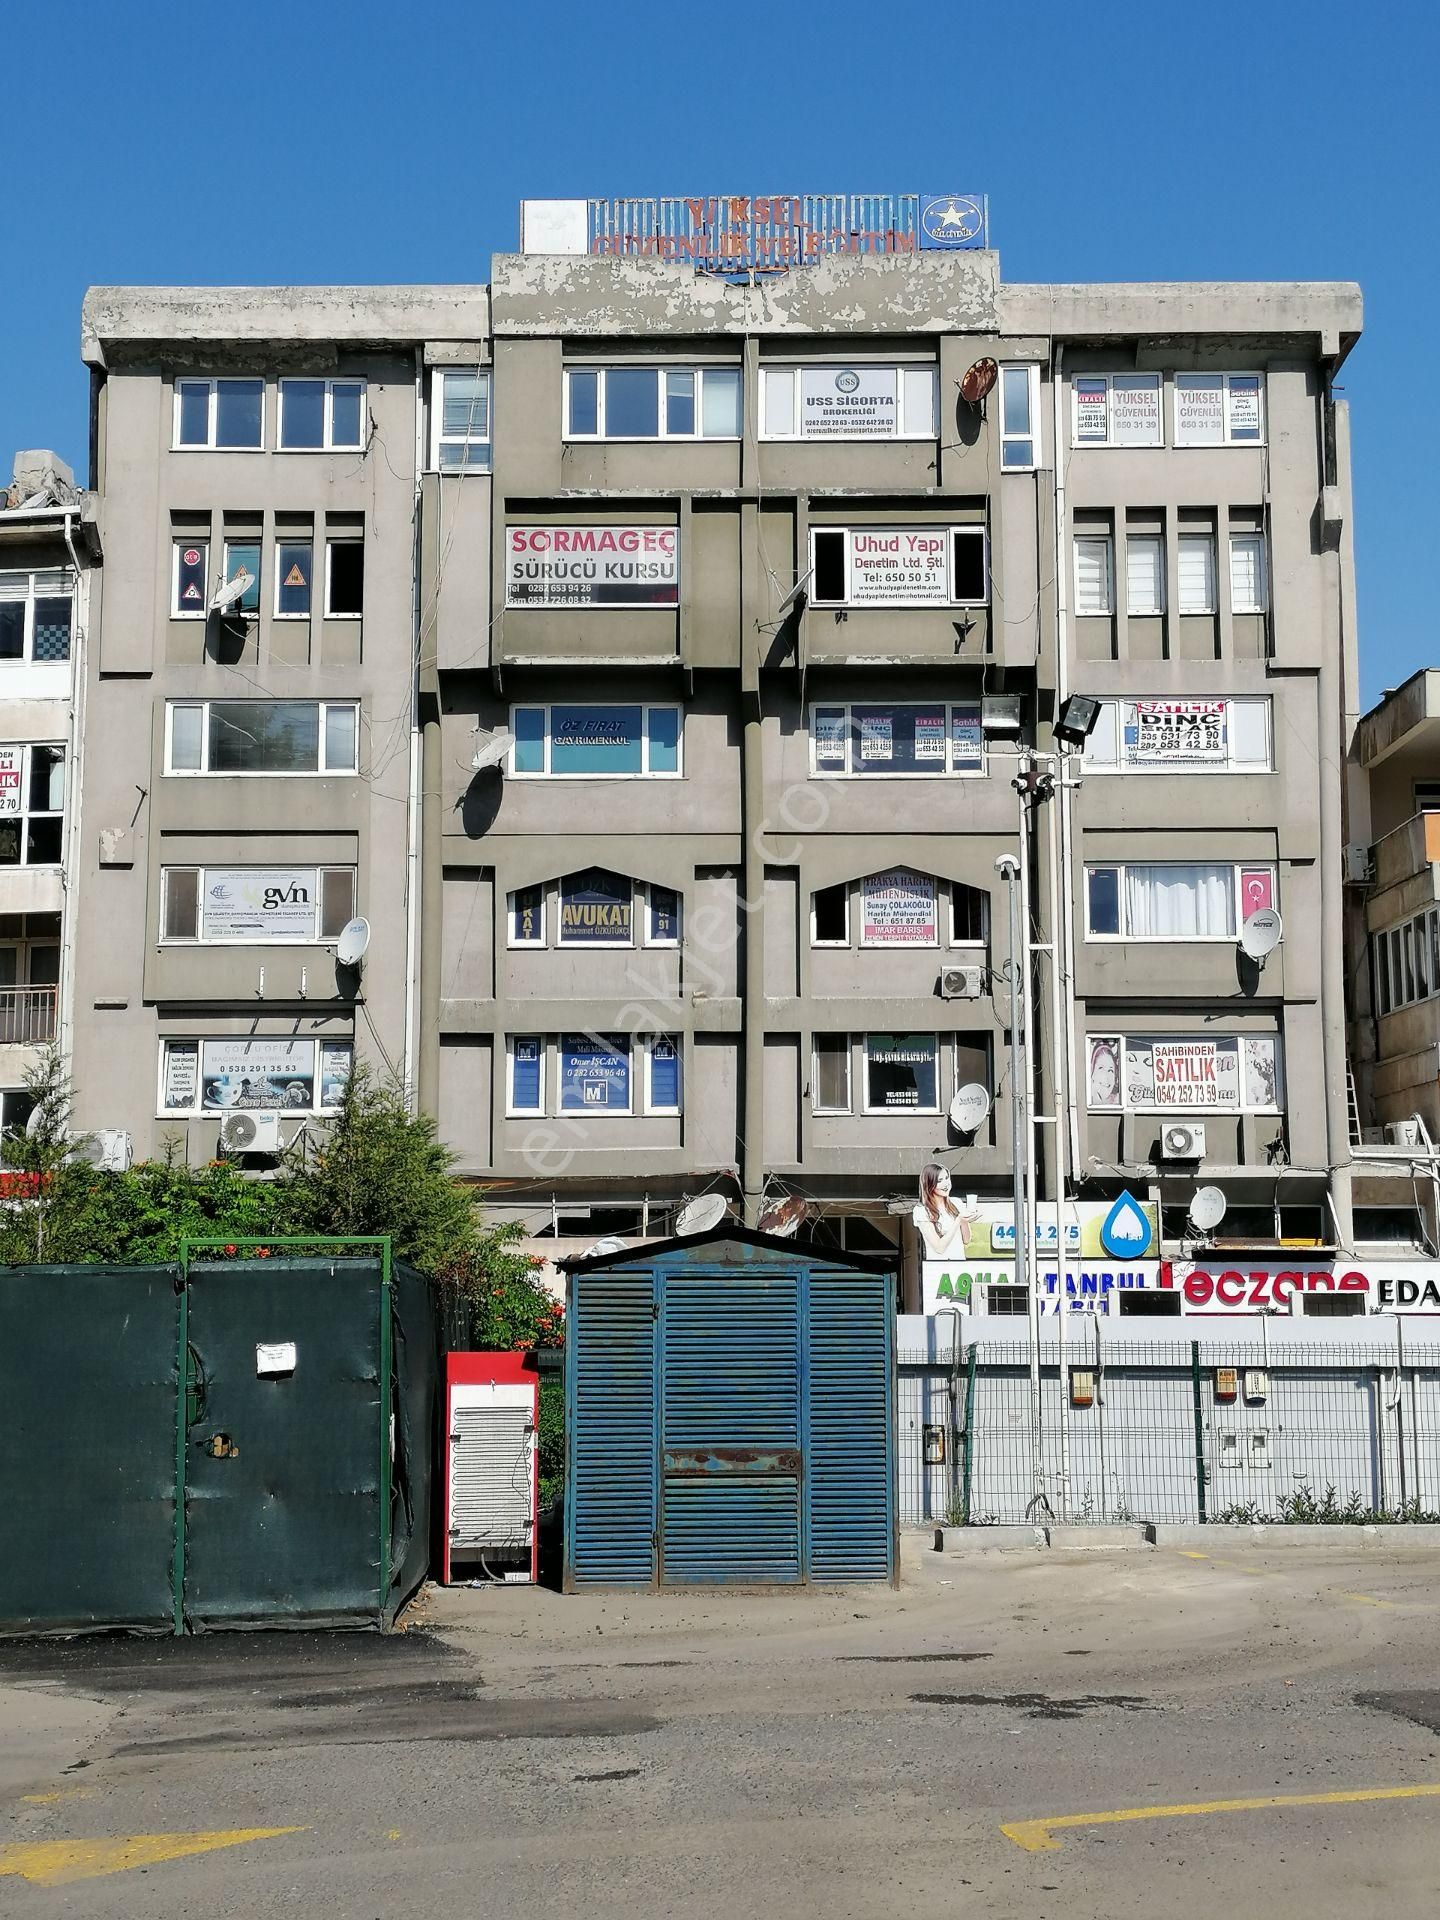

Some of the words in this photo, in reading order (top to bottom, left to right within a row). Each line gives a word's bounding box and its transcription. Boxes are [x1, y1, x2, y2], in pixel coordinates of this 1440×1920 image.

[806, 397, 833, 406] USS
[836, 396, 894, 406] SİGORTA
[1116, 390, 1156, 404] YÜKSEL
[1181, 390, 1221, 404] YÜKSEL
[1115, 404, 1157, 418] GÜVENLİK
[1180, 404, 1222, 416] GÜVENLİK
[512, 530, 675, 558] SORMAGEÇ
[855, 536, 898, 552] Uhud
[906, 536, 944, 555] Yapı
[513, 558, 597, 578] SÜRÜCÜ
[605, 562, 674, 578] KURSU
[855, 558, 898, 568] Denetim
[902, 558, 922, 568] Ltd.
[926, 558, 944, 570] Şti.
[863, 573, 882, 582] Tel:
[886, 573, 905, 582] 650
[908, 573, 922, 582] 50
[924, 573, 936, 582] 51
[508, 584, 520, 592] Tel
[550, 596, 566, 604] 726
[1186, 732, 1200, 740] 73
[1206, 731, 1218, 739] 90
[1186, 740, 1200, 748] 42
[1206, 740, 1218, 748] 58
[7, 799, 16, 809] 70
[866, 876, 898, 886] TRAKYA
[263, 881, 310, 910] gvn
[868, 888, 930, 898] MÜHENDİSLİK
[867, 902, 888, 910] Sunay
[889, 900, 932, 910] ÇOLAKOĞLU
[562, 904, 630, 926] AVUKAT
[658, 920, 669, 930] 91
[1155, 1046, 1214, 1056] SAHİBİNDEN
[568, 1069, 572, 1077] 0
[574, 1069, 588, 1077] 282
[589, 1069, 603, 1077] 653
[616, 1068, 626, 1077] 46
[1156, 1058, 1216, 1082] SATILIK
[1156, 1086, 1176, 1104] 0542
[1178, 1085, 1193, 1103] 252
[1195, 1084, 1204, 1102] 73
[1206, 1084, 1216, 1102] 59
[1048, 1226, 1079, 1238] 25
[1184, 1271, 1370, 1304] eczane
